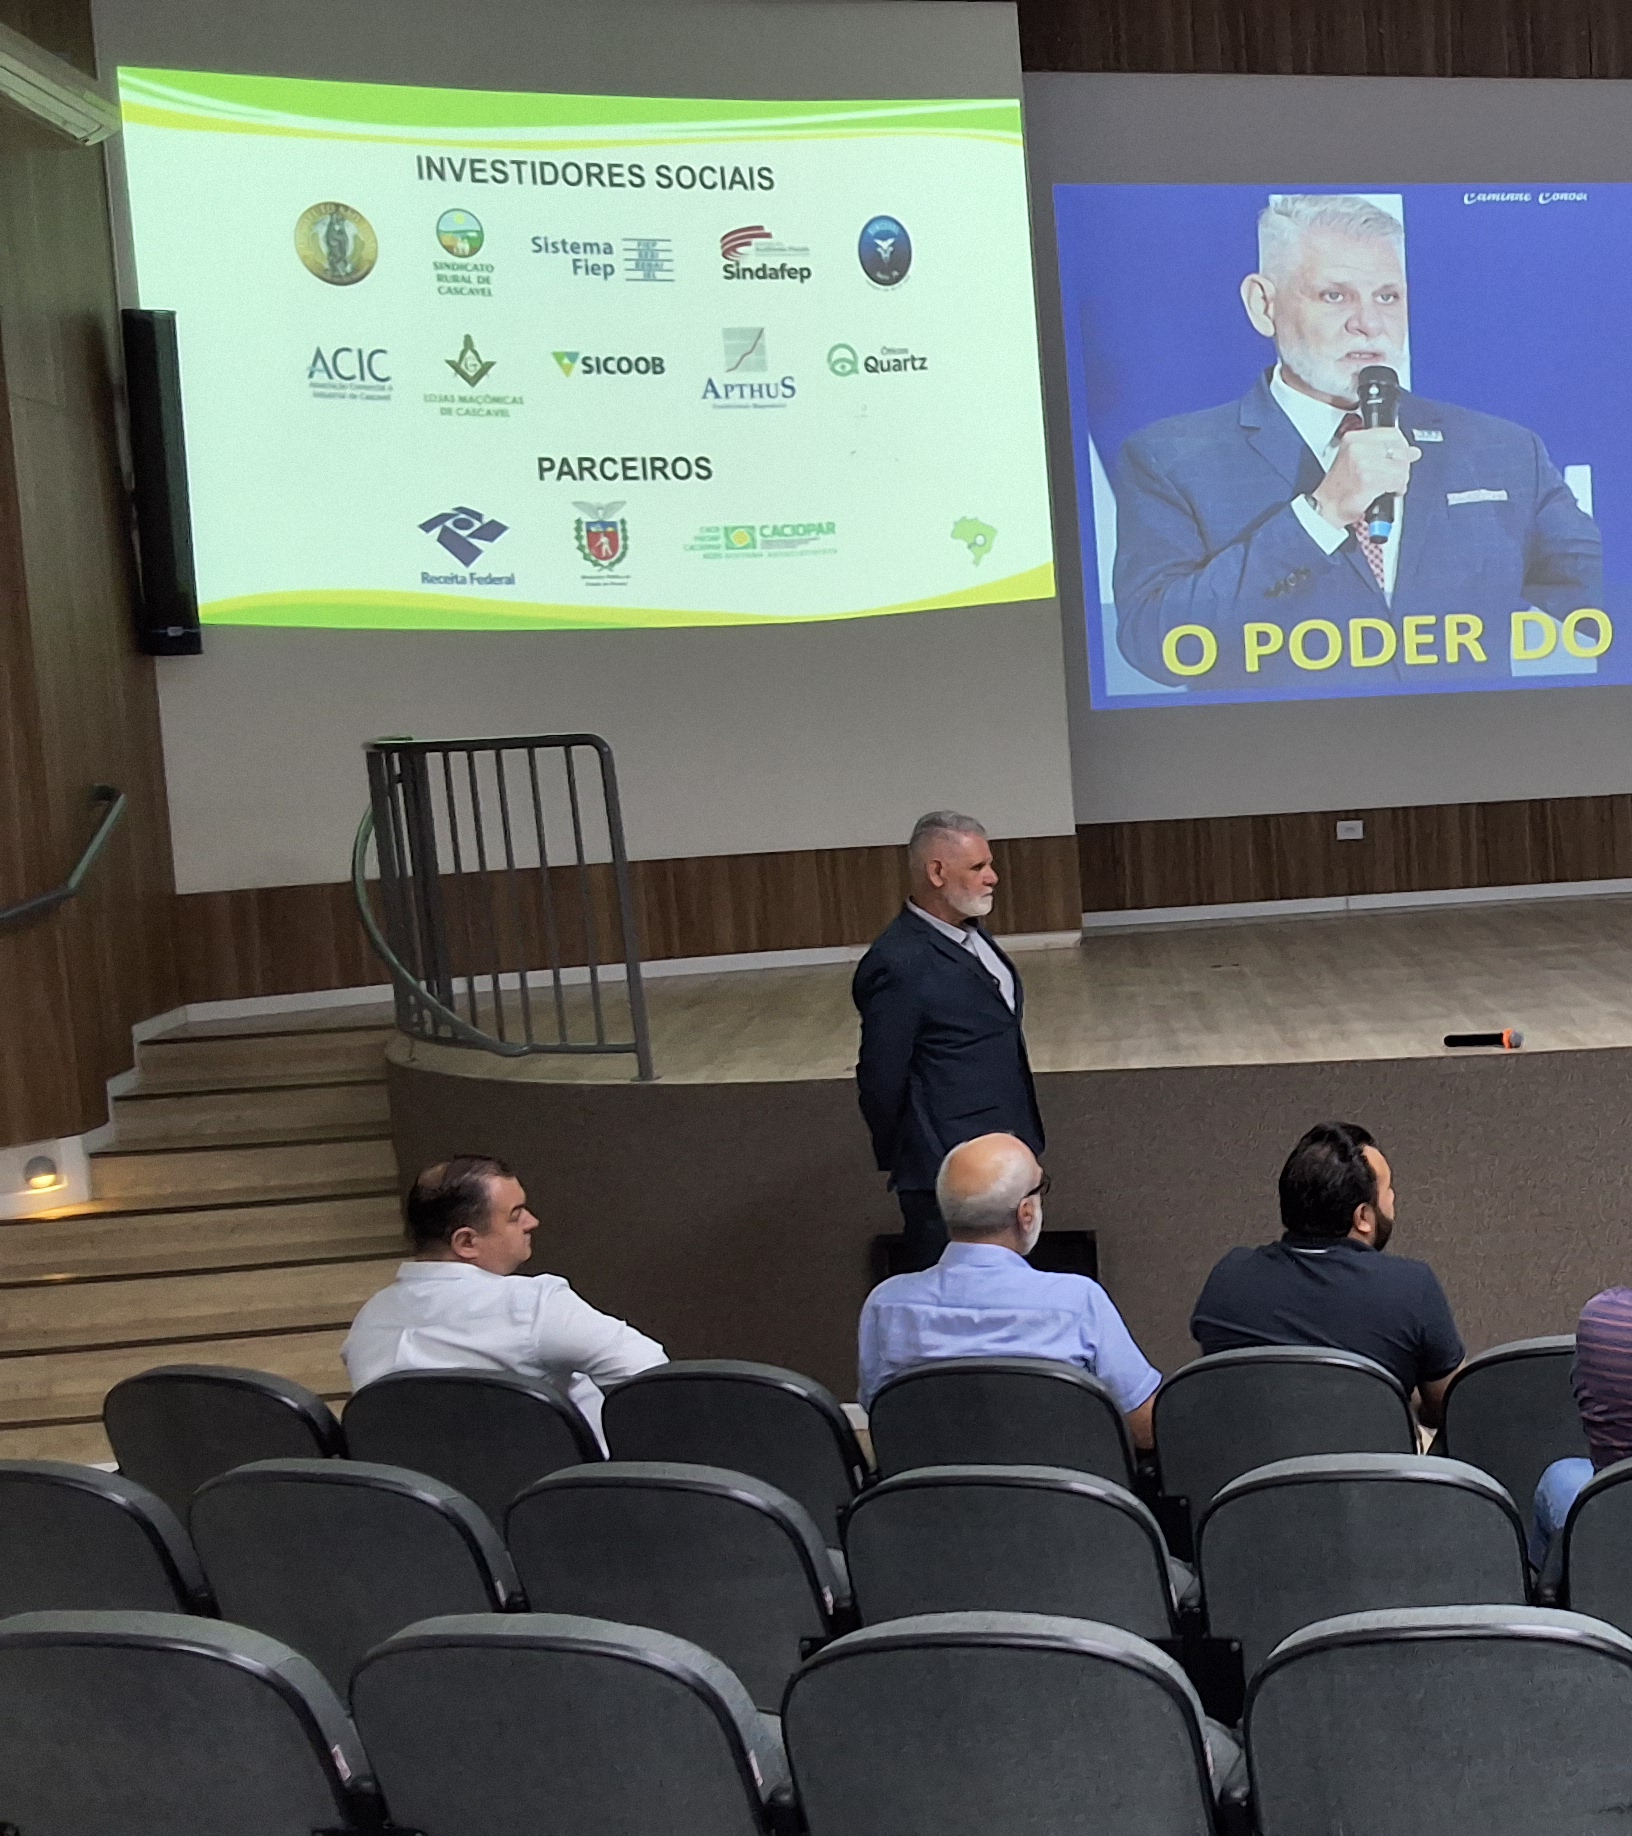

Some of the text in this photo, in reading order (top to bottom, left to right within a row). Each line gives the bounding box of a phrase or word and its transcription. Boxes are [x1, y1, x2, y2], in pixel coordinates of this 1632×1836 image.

[416, 154, 775, 191] INVESTIDORES SOCIAIS
[531, 236, 614, 255] Sistema
[432, 261, 495, 273] SINDICATO
[572, 258, 616, 281] Fiep
[722, 261, 813, 284] Sindafep
[477, 274, 491, 285] DE
[308, 346, 392, 383] ACIC
[581, 355, 666, 376] SICOOB
[863, 353, 929, 374] Quartz
[701, 375, 797, 401] APTHUS
[537, 455, 713, 482] PARCEIROS
[421, 572, 516, 586] Receita Federal
[1161, 623, 1218, 677] O
[1243, 613, 1488, 673] PODER
[1510, 607, 1614, 661] DO
